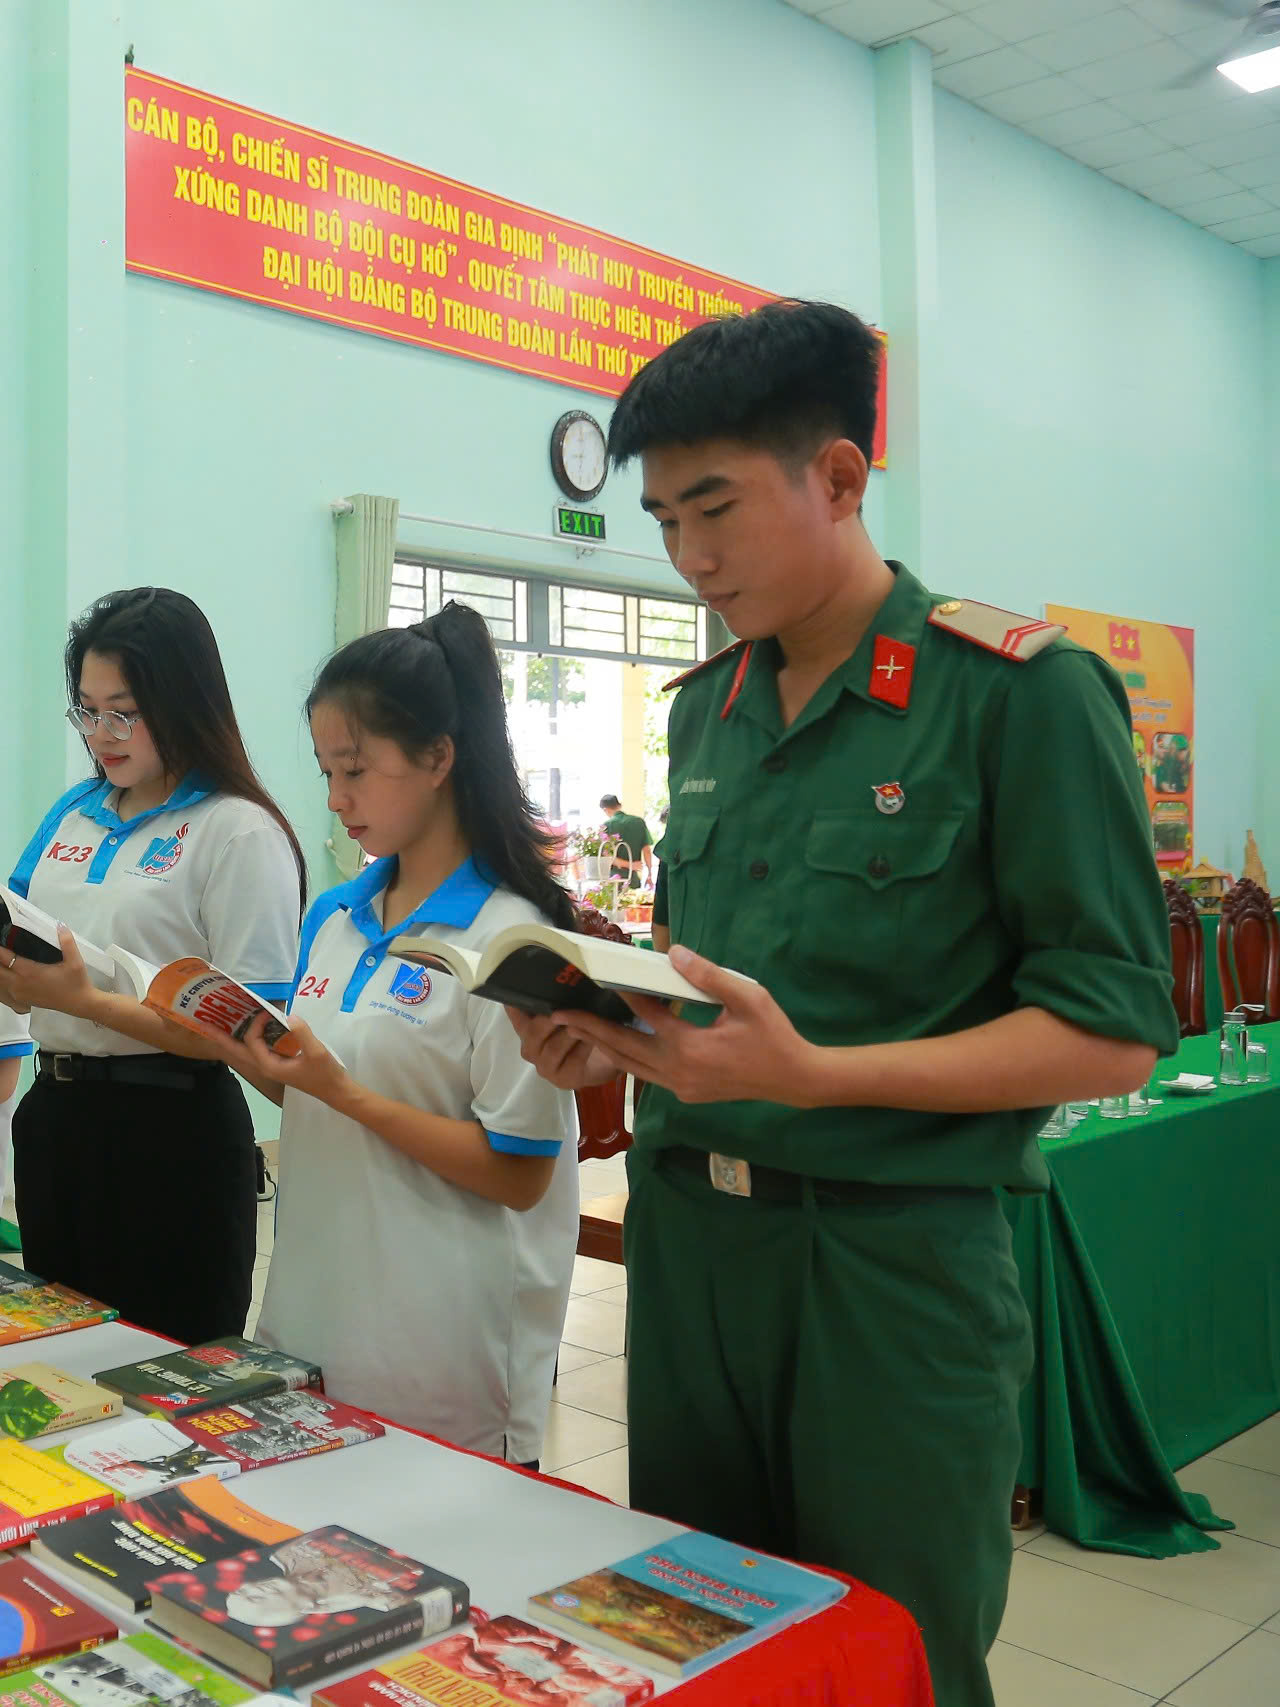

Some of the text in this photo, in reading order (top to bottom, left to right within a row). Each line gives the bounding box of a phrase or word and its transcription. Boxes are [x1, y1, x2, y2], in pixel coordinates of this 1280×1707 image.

[127, 97, 179, 145] CÁN
[186, 116, 226, 163] BỘ,
[232, 132, 300, 183] CHIẾN
[306, 156, 328, 192] SĨ
[334, 165, 401, 216] TRUNG
[406, 189, 460, 236] ĐOÀN
[465, 210, 496, 248] GIA
[500, 223, 543, 264] ĐỊNH
[603, 258, 633, 292] HUY
[637, 269, 694, 313] TRUYỀN
[174, 165, 240, 217] XỨNG
[247, 189, 308, 237] DANH
[314, 210, 343, 256] BỘ
[348, 219, 383, 262] ĐỘI
[389, 234, 415, 275] CỤ
[468, 259, 522, 301] QUYẾT
[528, 275, 564, 314] TÂM
[569, 290, 611, 332] THỰC
[615, 304, 651, 343] HIỆN
[263, 246, 627, 377] ĐẠI HỘI ĐẢNG BỘ TRUNG ĐOÀN LẦN THỨ
[560, 508, 603, 538] EXIT
[47, 841, 93, 863] K23
[297, 976, 330, 999] 24
[365, 1680, 403, 1699] NAM
